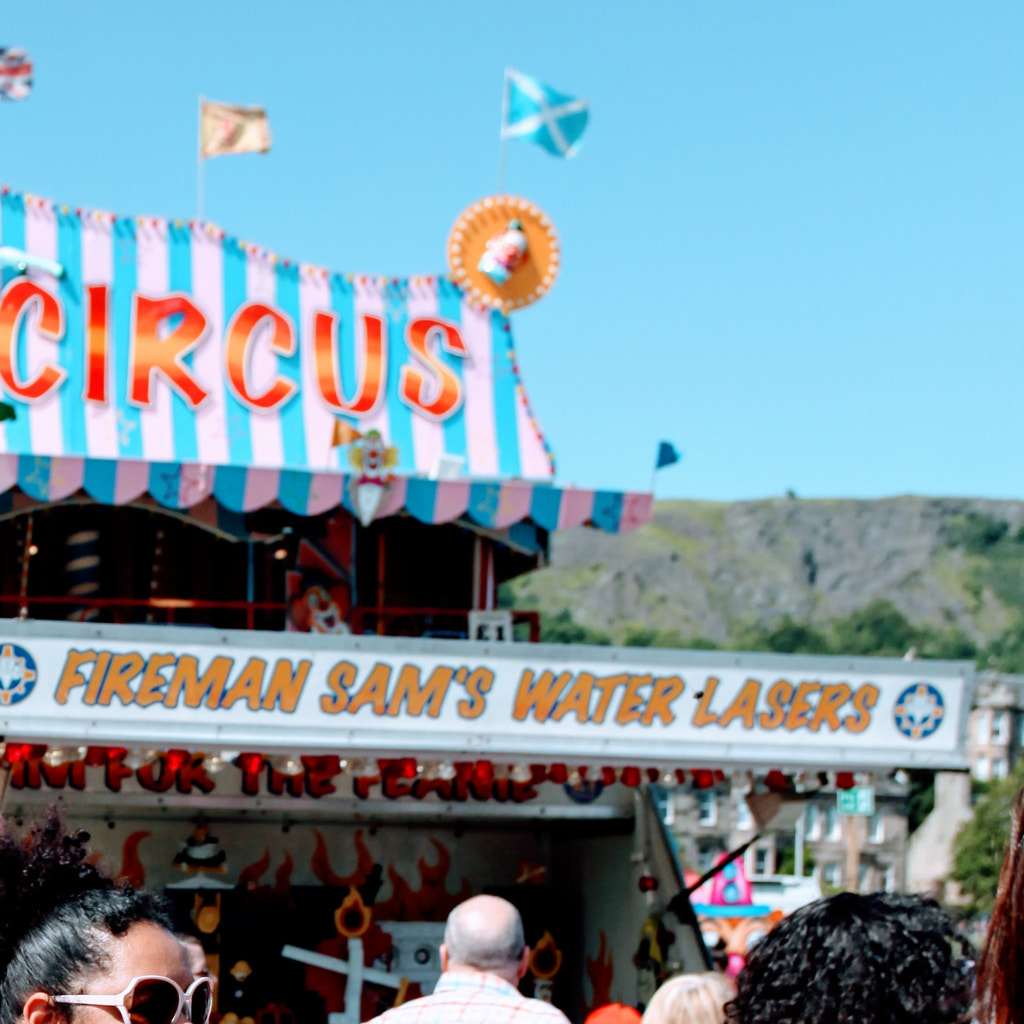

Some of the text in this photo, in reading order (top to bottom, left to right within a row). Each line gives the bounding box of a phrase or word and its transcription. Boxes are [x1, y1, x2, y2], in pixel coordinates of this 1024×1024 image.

[55, 648, 880, 734] FIREMAN SAM'S WATER LASERS
